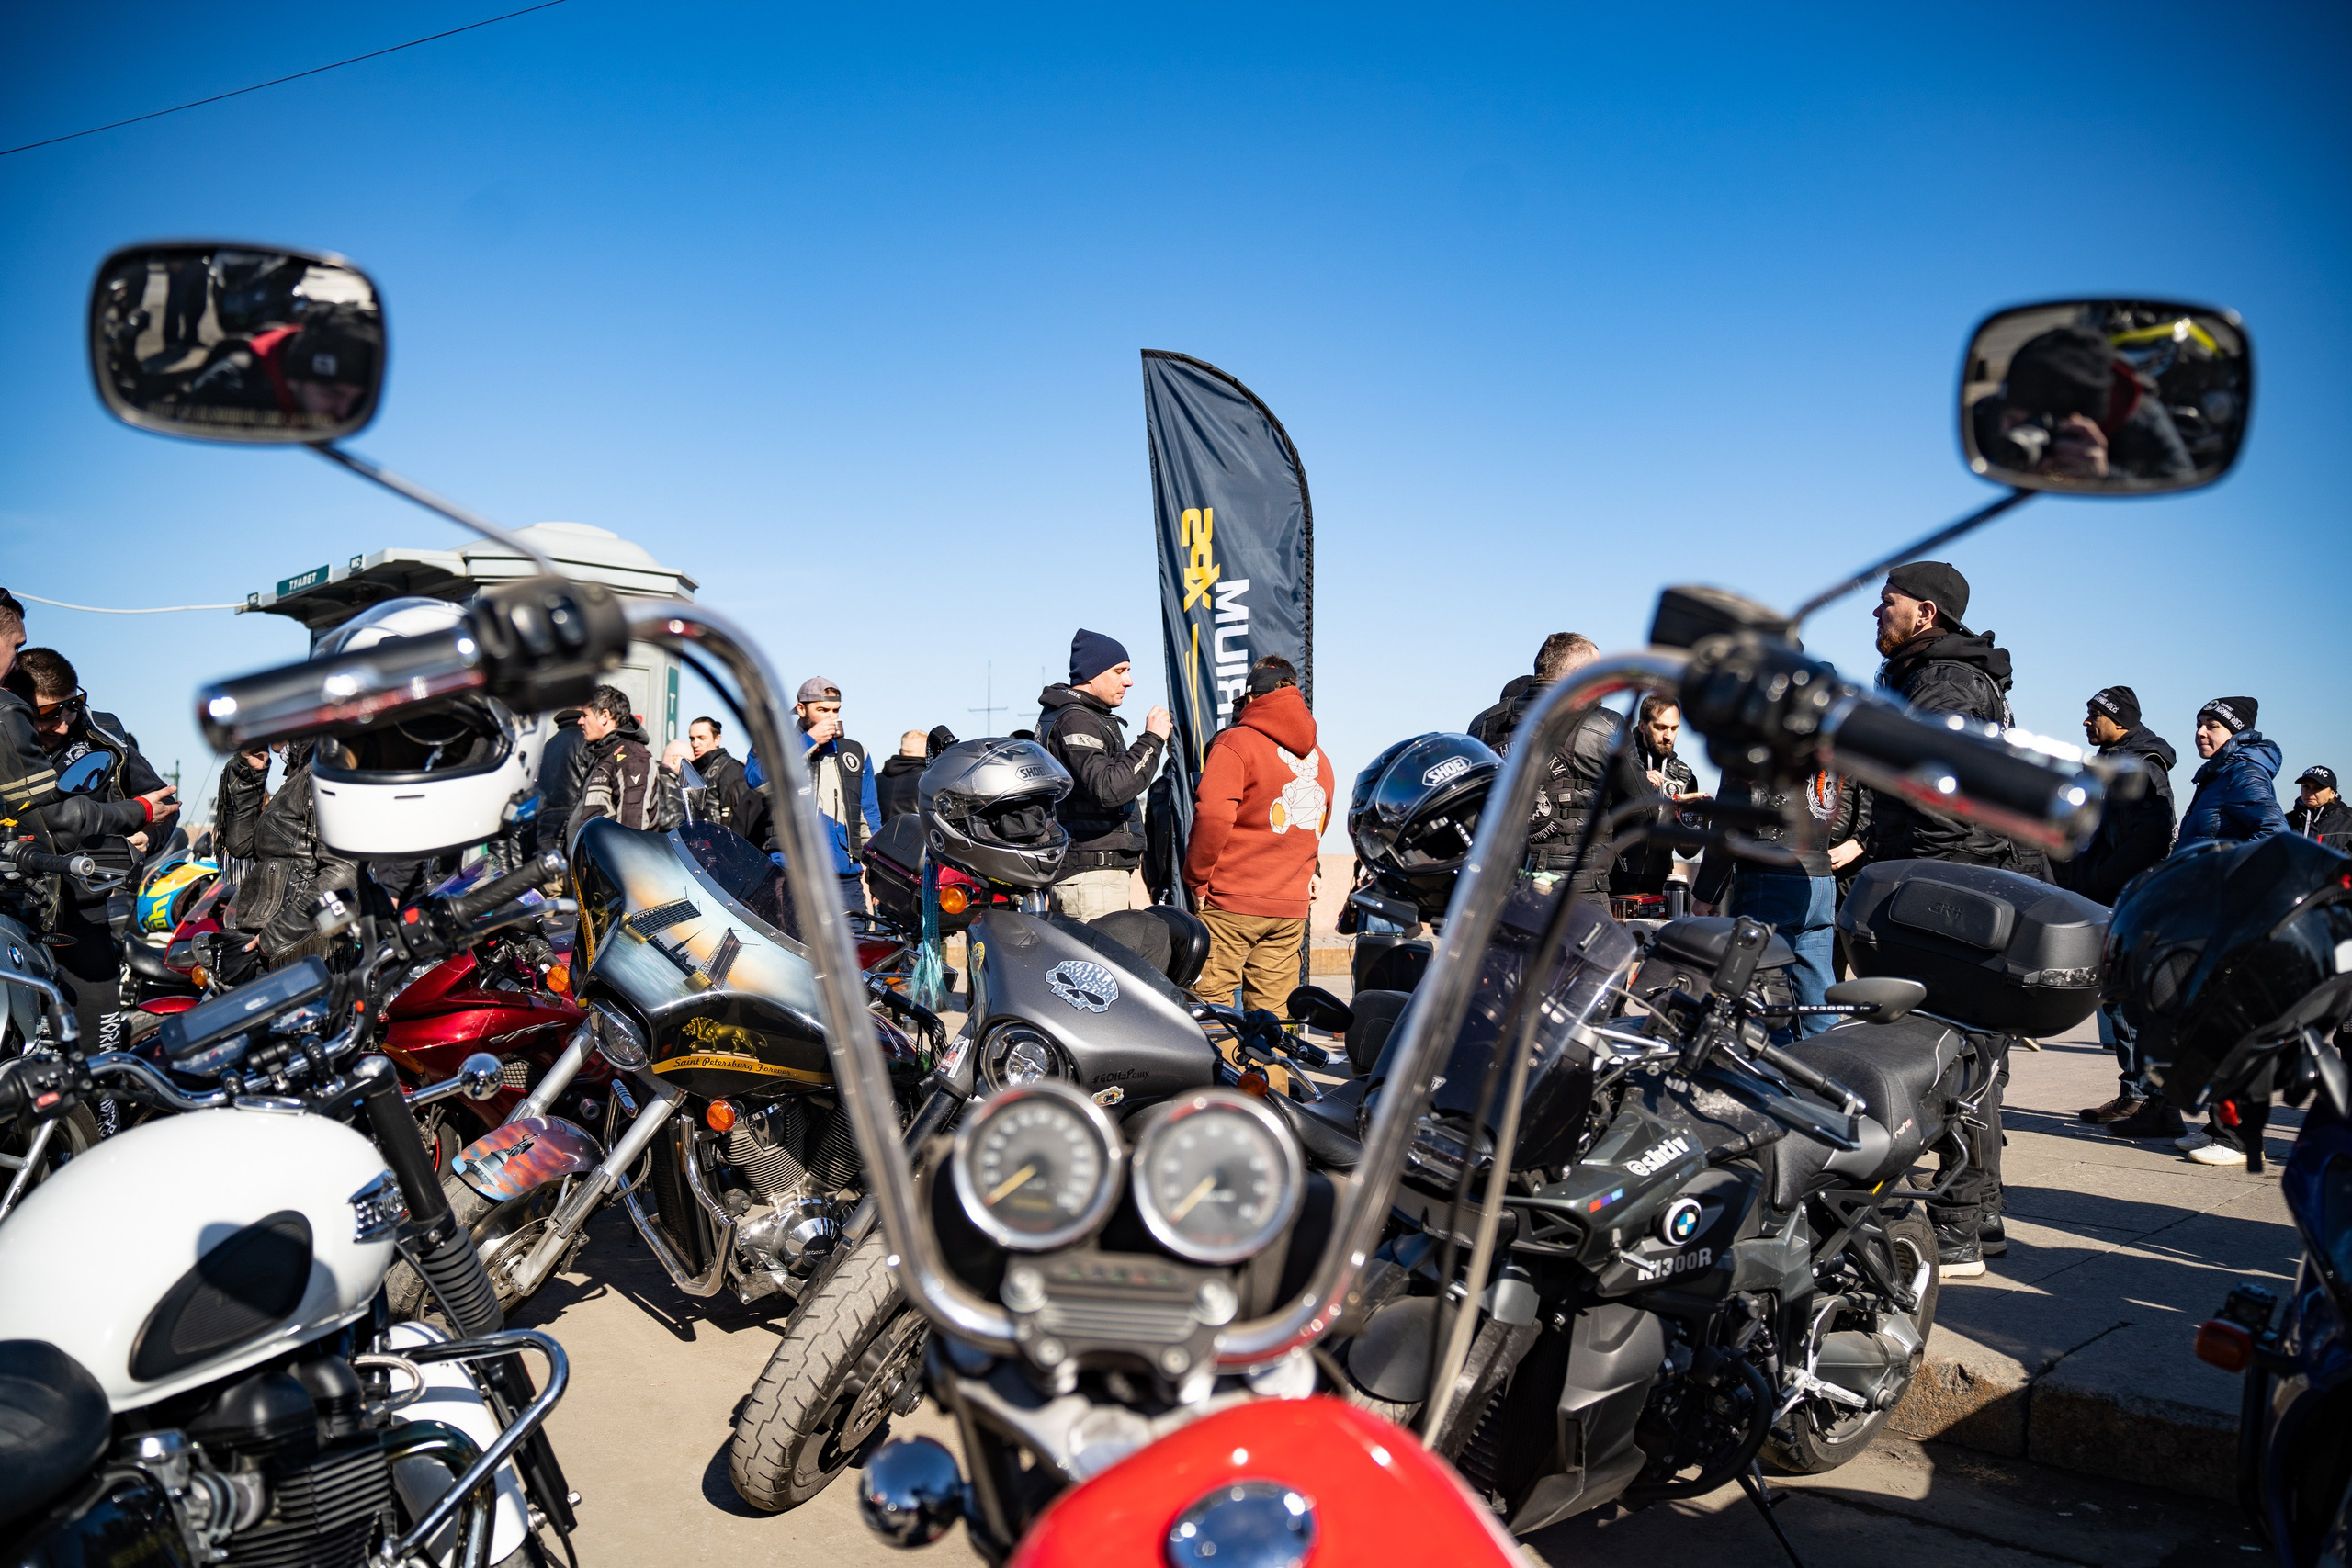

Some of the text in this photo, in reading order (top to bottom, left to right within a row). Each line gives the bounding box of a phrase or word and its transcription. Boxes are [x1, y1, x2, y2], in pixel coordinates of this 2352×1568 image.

[288, 571, 318, 591] ТУАЛЕТ
[1427, 758, 1469, 784] SHOEI
[673, 1057, 700, 1068] Saint
[701, 1057, 753, 1072] Petersburg
